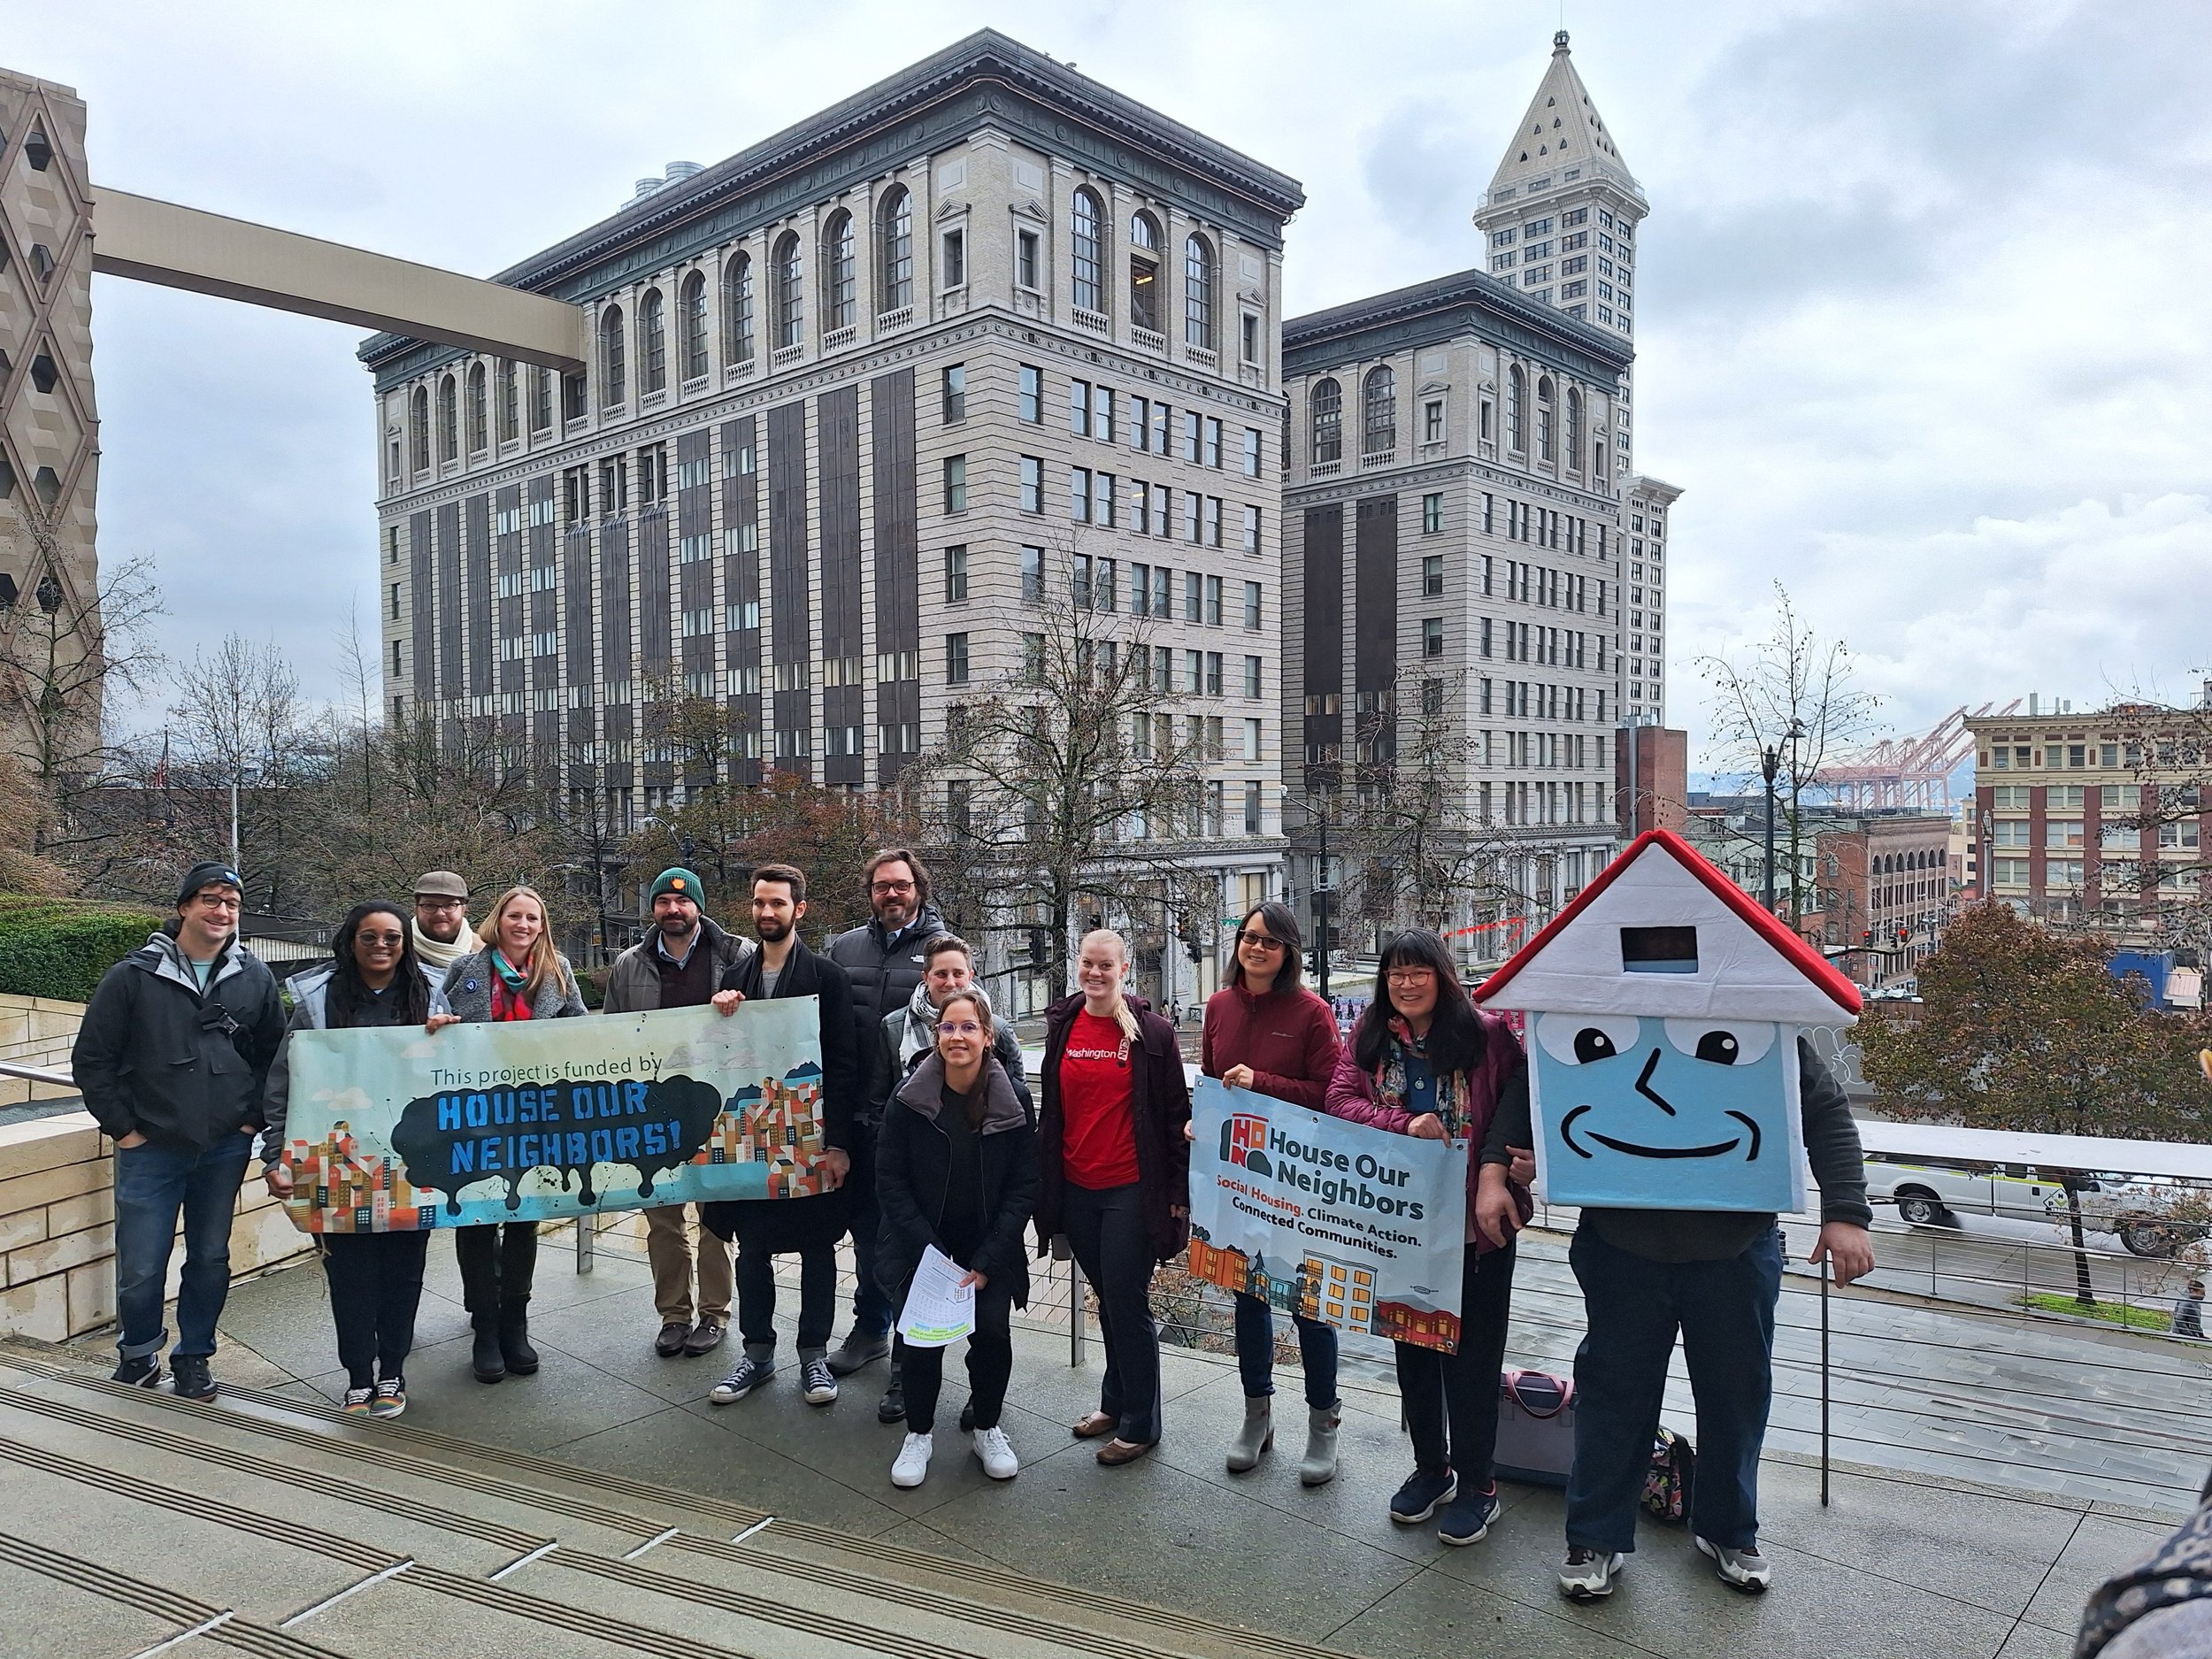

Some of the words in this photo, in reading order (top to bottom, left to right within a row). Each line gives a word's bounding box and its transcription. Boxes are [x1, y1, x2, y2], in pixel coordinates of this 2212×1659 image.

[430, 1068, 472, 1086] This
[479, 1064, 541, 1087] project
[545, 1063, 559, 1079] is
[565, 1056, 632, 1079] funded
[640, 1055, 663, 1075] by
[1066, 1048, 1117, 1060] Washington
[1118, 1039, 1130, 1061] CAN
[437, 1088, 561, 1131] HOUSE
[572, 1081, 649, 1120] OUR
[450, 1119, 681, 1175] NEIGHBORS!
[1270, 1126, 1349, 1172] House
[1355, 1154, 1410, 1187] Our
[1217, 1174, 1248, 1196] Social
[1251, 1187, 1304, 1217] Housing.
[1307, 1207, 1364, 1232] Climate
[1367, 1224, 1423, 1247] Action.
[1278, 1160, 1425, 1221] Neighbors
[1232, 1195, 1294, 1230] Connected
[1297, 1220, 1398, 1259] Communities.
